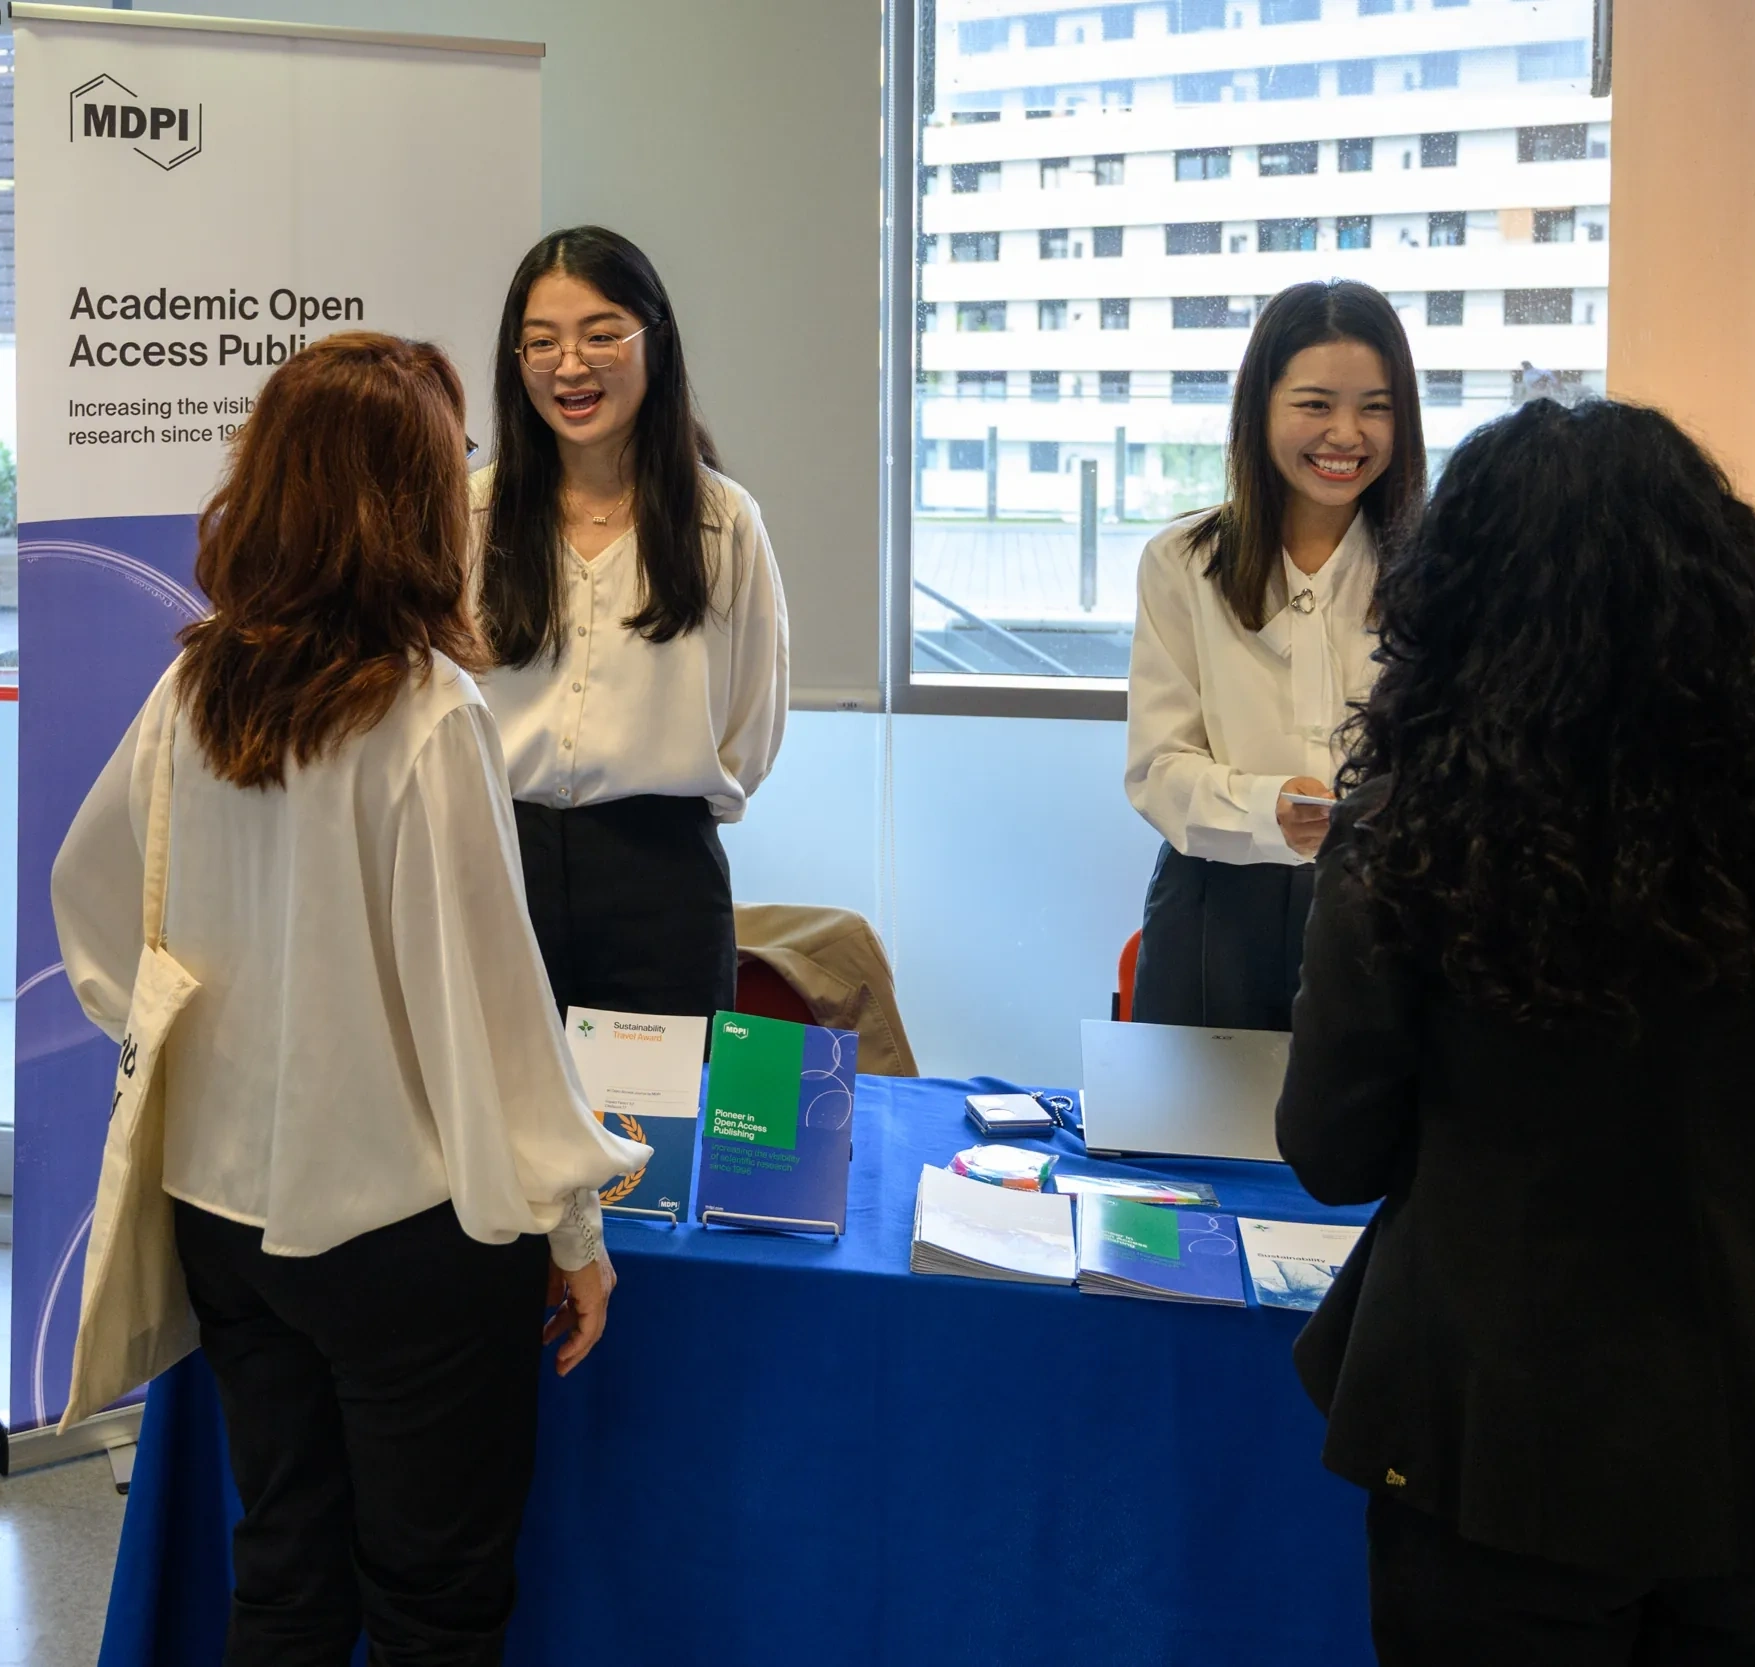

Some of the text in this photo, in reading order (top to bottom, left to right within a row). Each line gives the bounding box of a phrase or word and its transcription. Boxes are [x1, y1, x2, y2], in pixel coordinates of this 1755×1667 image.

[83, 103, 189, 142] MDPI
[69, 286, 365, 328] Academic Open
[69, 334, 314, 367] Access Publi
[69, 398, 172, 419] Increasing
[177, 397, 208, 415] the
[68, 426, 155, 445] research
[160, 425, 213, 442] since
[613, 1021, 666, 1034] Sustainability
[725, 1025, 747, 1035] MDPI
[613, 1030, 663, 1042] Travel Award
[715, 1108, 755, 1122] Pioneer in
[713, 1125, 755, 1141] Publishing
[714, 1117, 768, 1133] Open Access
[711, 1143, 800, 1165] Increasing the visibility
[709, 1162, 731, 1172] since
[710, 1152, 793, 1173] of scientific research
[660, 1200, 678, 1208] MDPI
[1257, 1252, 1326, 1264] Sustainability
